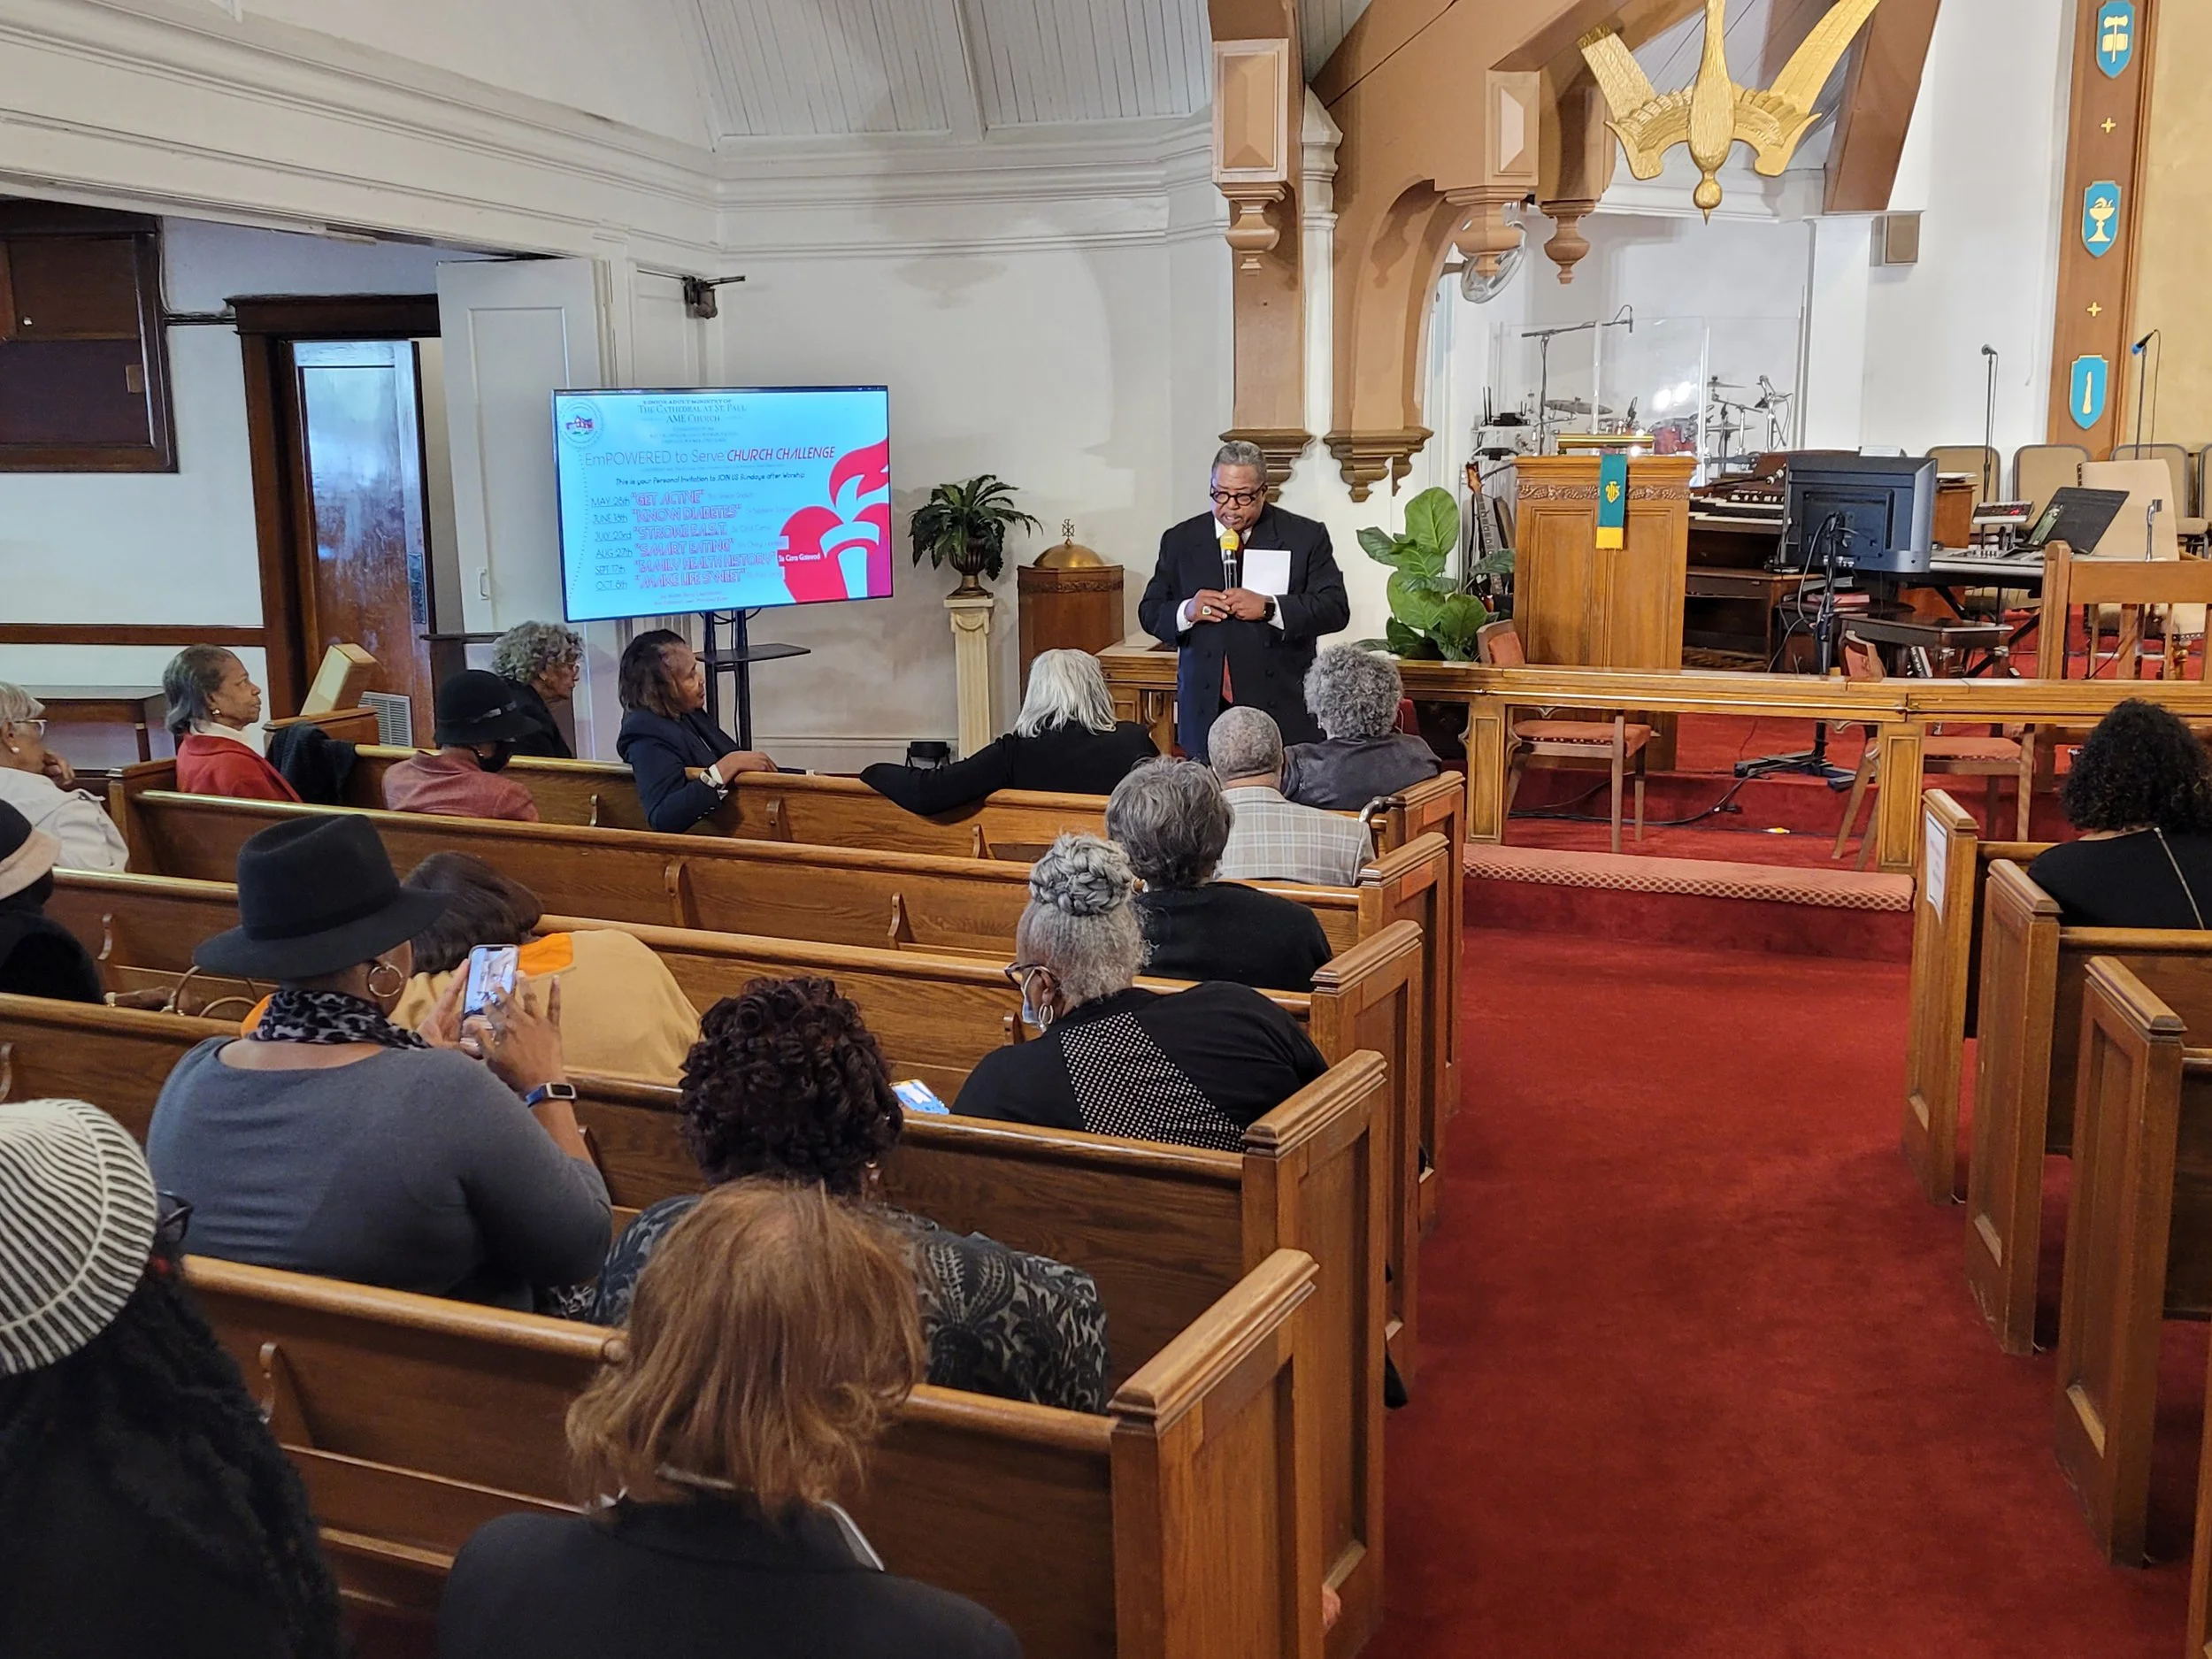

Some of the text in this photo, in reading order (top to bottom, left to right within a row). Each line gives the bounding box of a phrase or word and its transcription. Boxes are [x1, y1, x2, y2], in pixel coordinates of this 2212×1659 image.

[637, 404, 656, 414] THE
[656, 403, 702, 414] CATHEDRAL
[703, 404, 714, 413] AT
[726, 403, 747, 412] PAUL
[666, 414, 720, 424] AME CHURCH
[585, 446, 835, 466] EmPOWERED to Serve CHURCH CHALLENGE
[653, 476, 680, 485] Personal
[591, 496, 611, 507] MAY
[680, 571, 701, 586] LIFE
